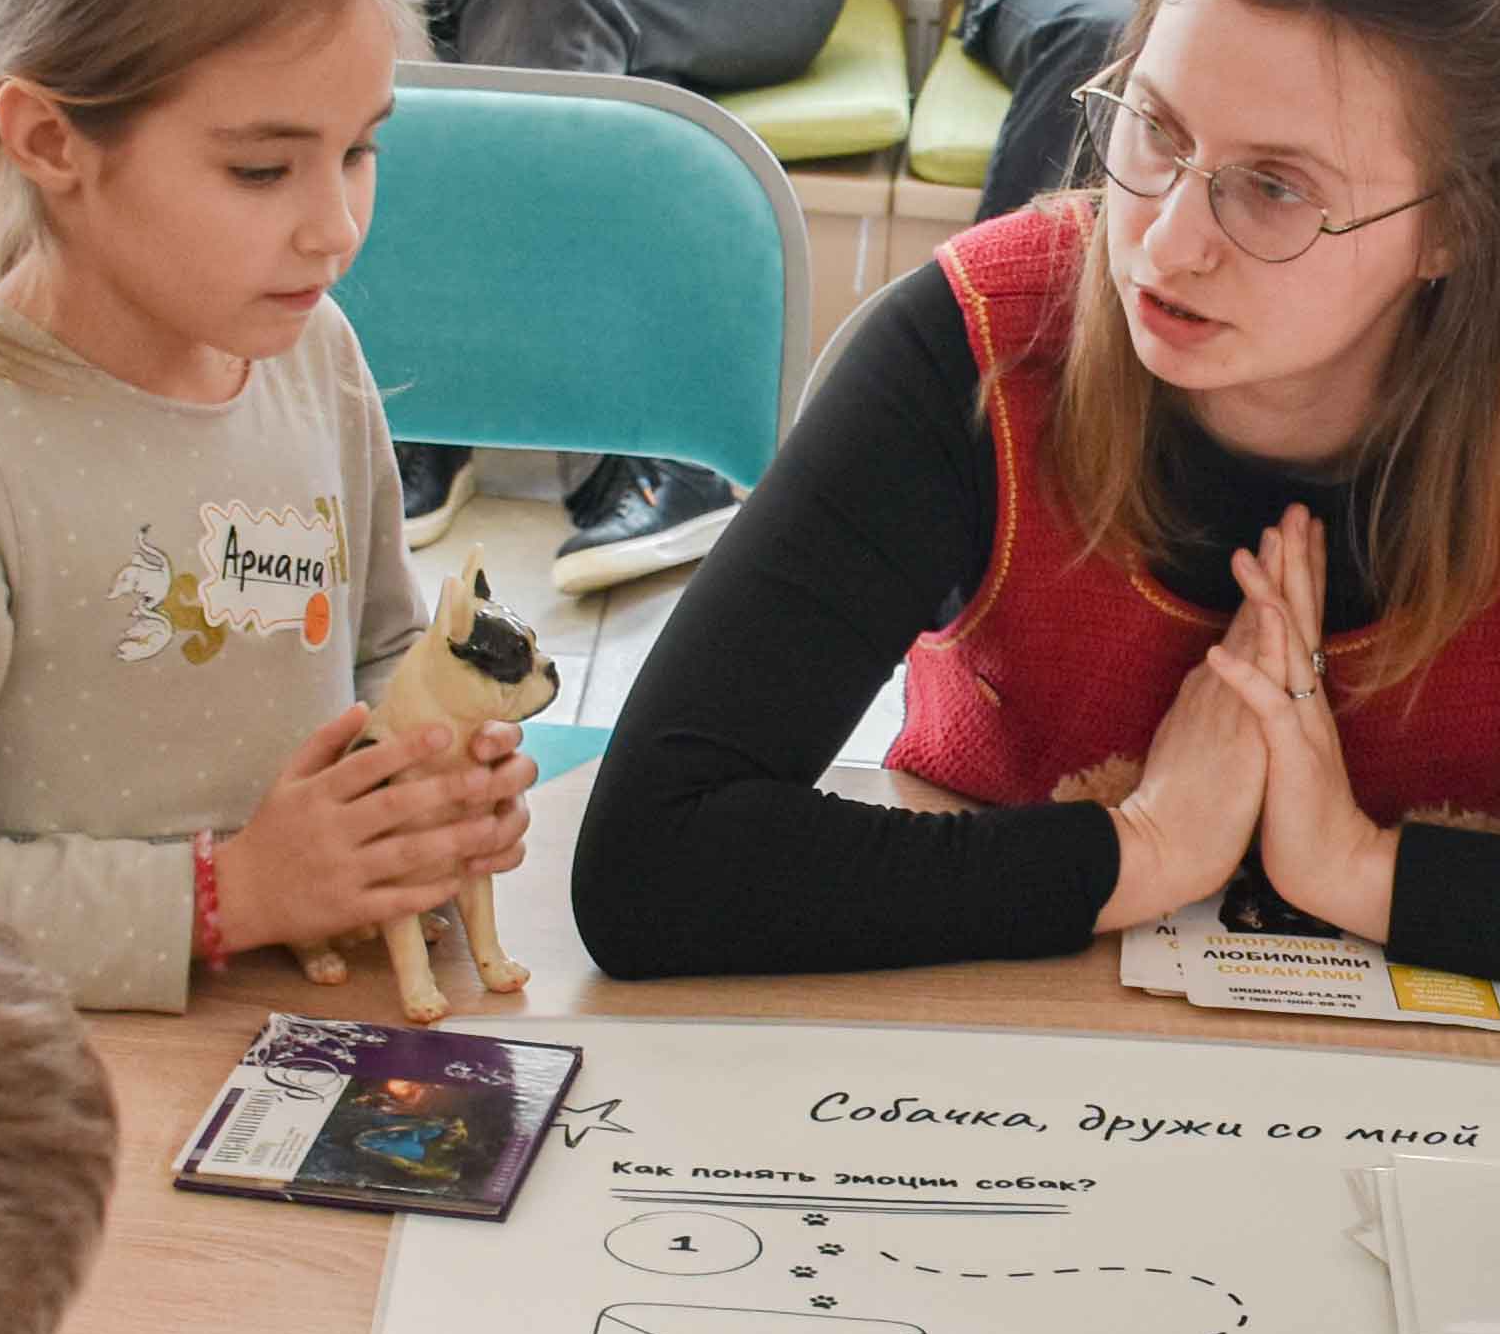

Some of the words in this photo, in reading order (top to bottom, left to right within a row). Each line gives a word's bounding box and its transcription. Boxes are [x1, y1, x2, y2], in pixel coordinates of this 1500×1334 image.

[221, 525, 325, 593] Ариана
[1204, 935, 1337, 953] ПРОГУЛКИ
[1203, 949, 1371, 969] ЛЮБИМЫМИ
[1218, 964, 1364, 982] СОБАКАМИ
[810, 1092, 1047, 1132] Собачка,
[1079, 1104, 1242, 1142] дружи
[1267, 1124, 1322, 1139] со
[1345, 1125, 1479, 1147] мной
[612, 1161, 674, 1177] Как
[692, 1168, 817, 1183] понять
[834, 1173, 959, 1191] эмоции
[976, 1176, 1097, 1193] собак?
[668, 1236, 699, 1253] 1
